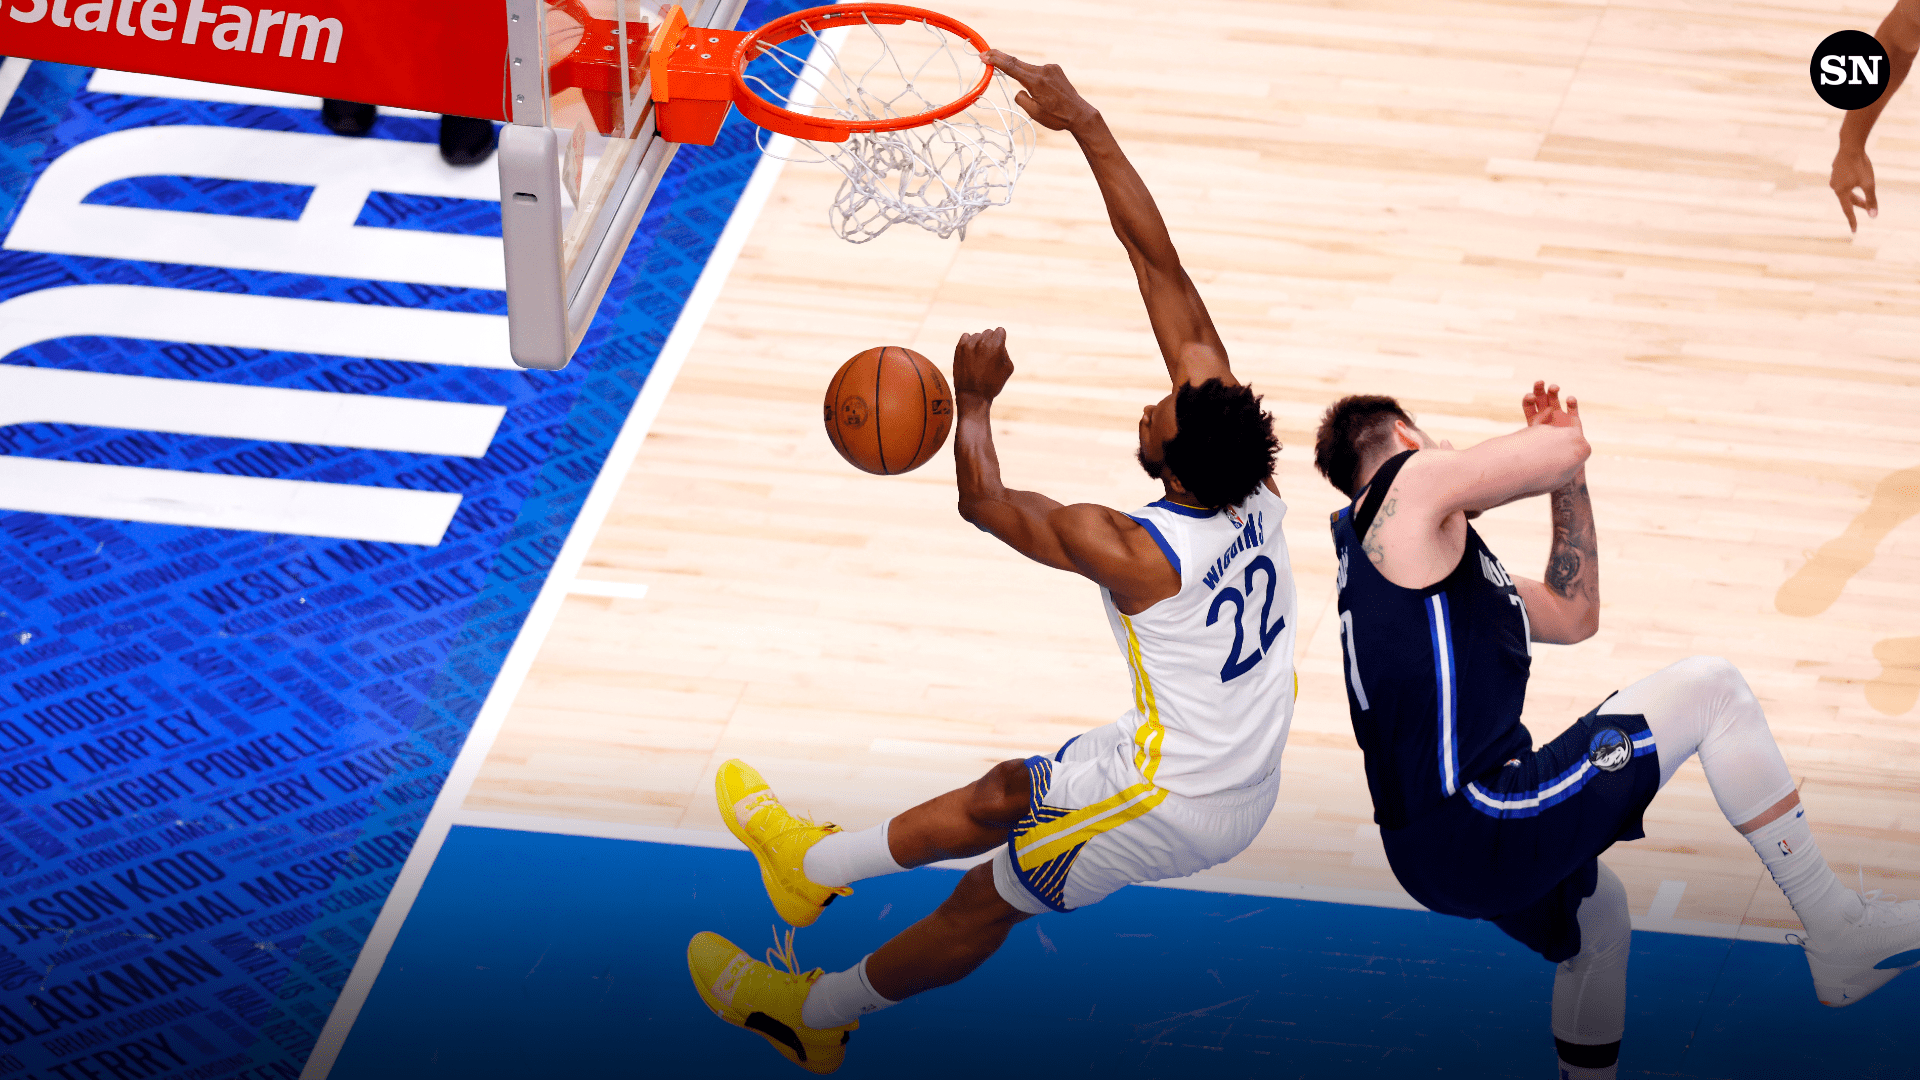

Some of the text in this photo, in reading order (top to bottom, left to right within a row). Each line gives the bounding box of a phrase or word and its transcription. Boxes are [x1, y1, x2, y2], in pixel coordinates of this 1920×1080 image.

[187, 553, 333, 616] WESLEY
[389, 564, 482, 613] DALE
[1206, 555, 1286, 683] 22
[10, 641, 163, 703] ARMSTRONG
[22, 684, 147, 739] HODGE
[0, 754, 70, 797] ROY
[57, 709, 212, 774] TARPLEY
[51, 725, 336, 827] DWIGHT POWELL
[207, 739, 434, 828] TERRY DAVIS
[63, 835, 163, 877] BERNARD
[5, 880, 130, 945] JASON
[112, 848, 228, 904] KIDD
[131, 890, 257, 943] JAMAL
